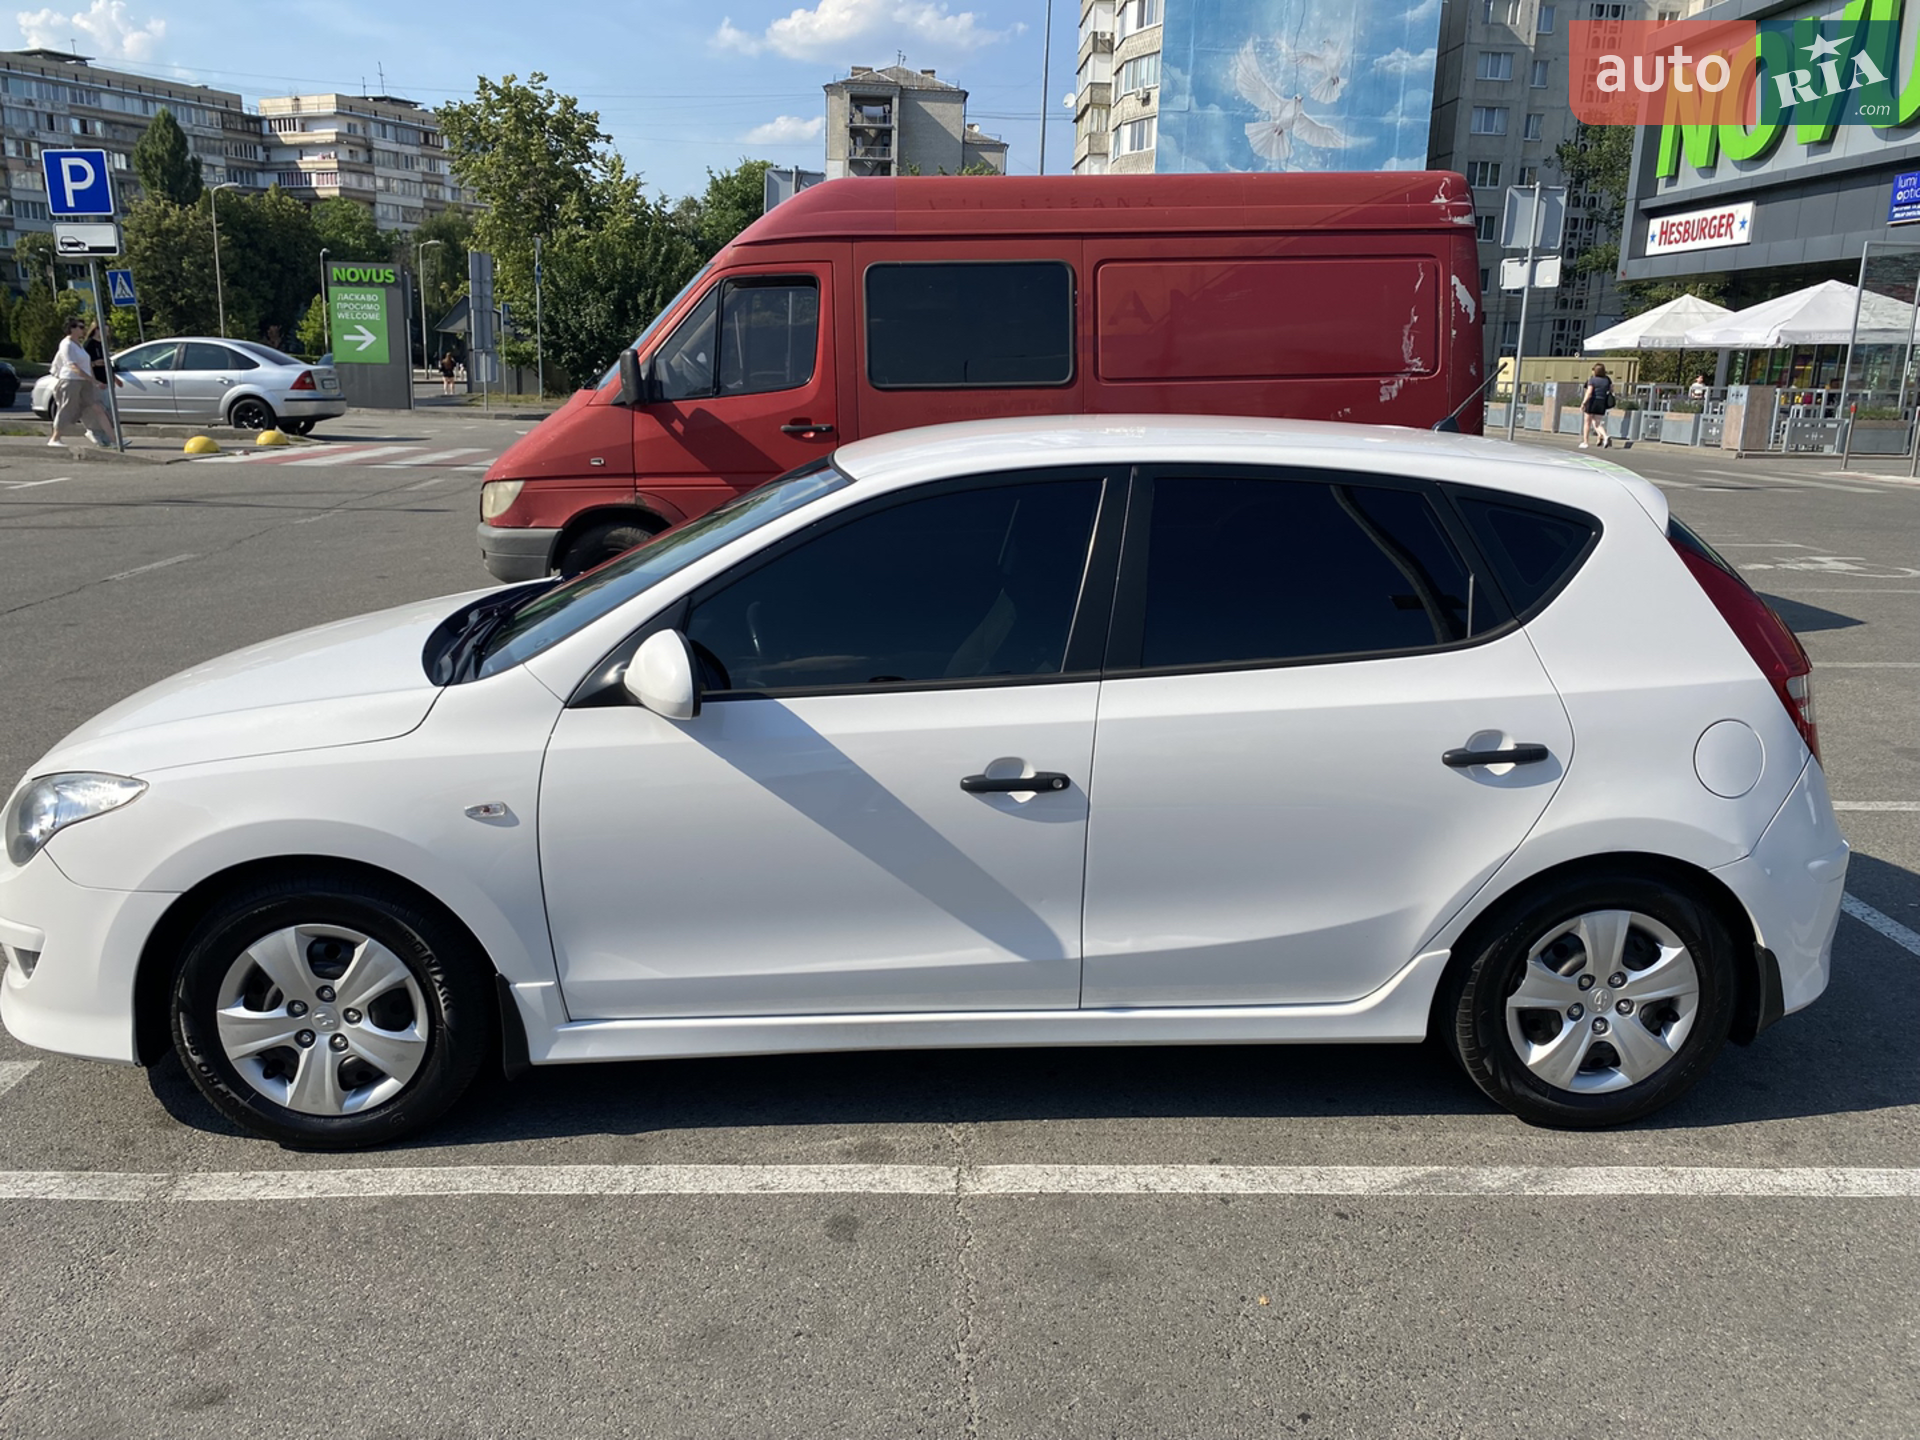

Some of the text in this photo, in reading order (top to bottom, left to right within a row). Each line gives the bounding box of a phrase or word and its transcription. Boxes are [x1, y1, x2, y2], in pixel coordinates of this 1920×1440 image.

[60, 157, 95, 208] P
[1658, 212, 1735, 247] HESBURGER
[332, 267, 395, 283] NOVUS
[337, 293, 378, 302] ЛАСКАВО
[336, 302, 380, 311] ПРОСИМО
[336, 312, 380, 321] WELCOME
